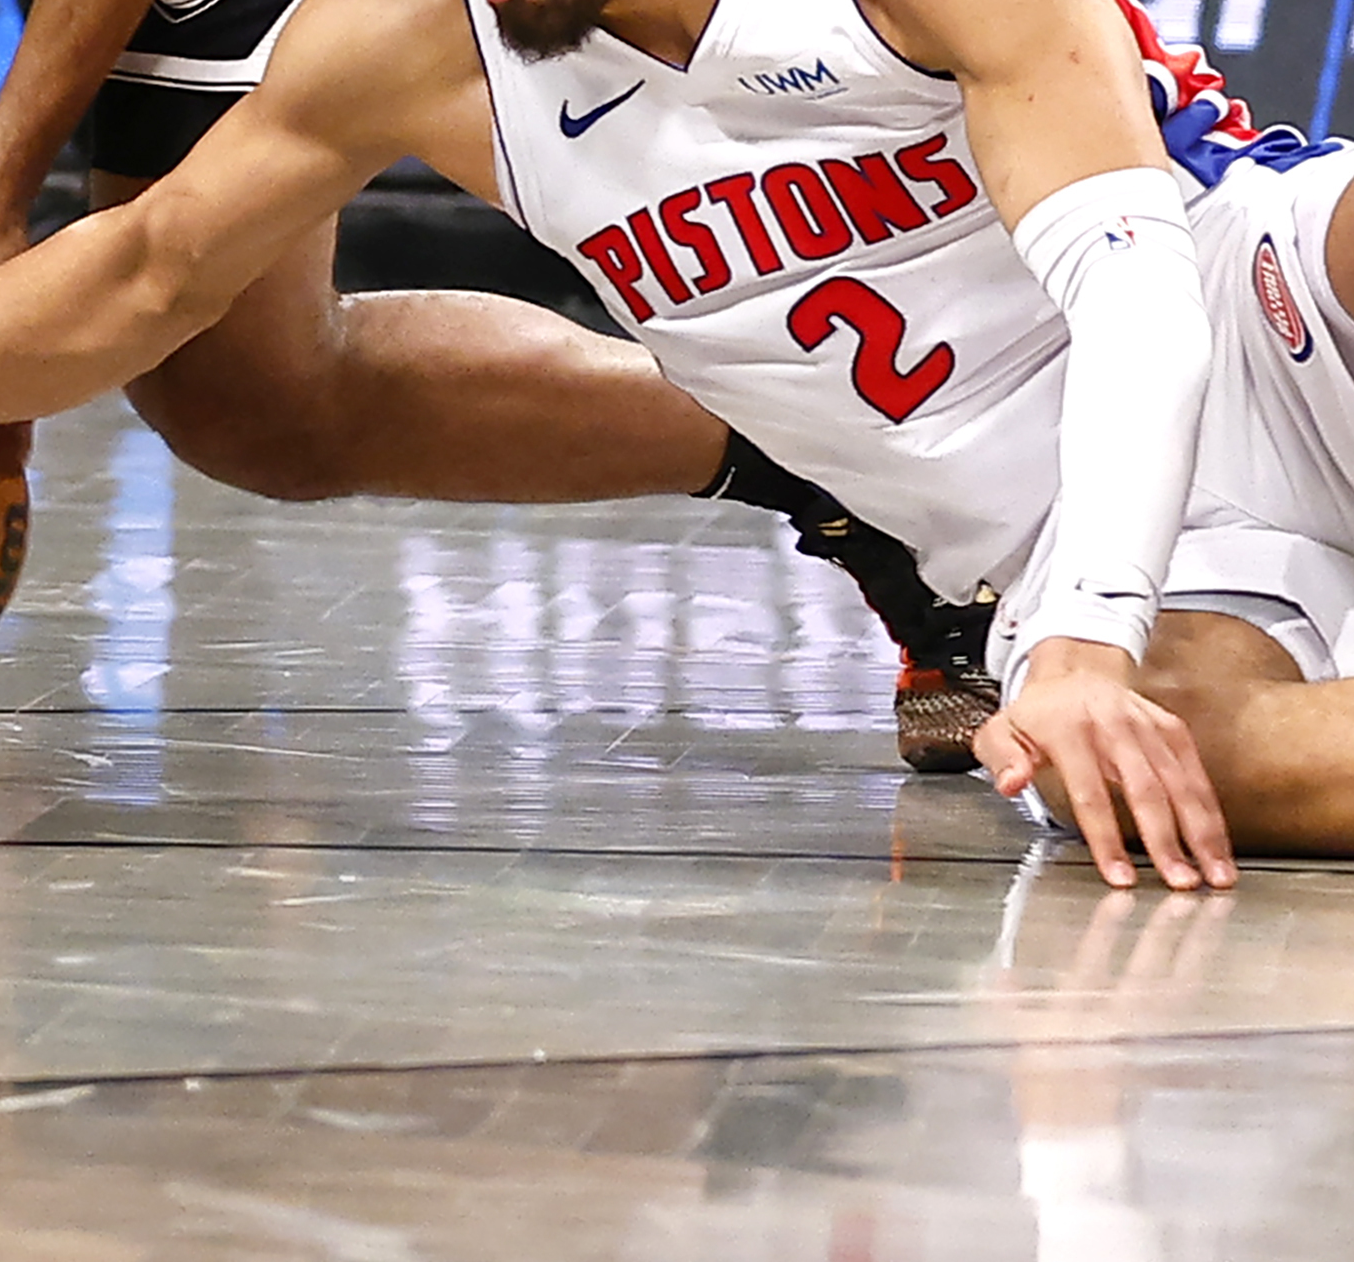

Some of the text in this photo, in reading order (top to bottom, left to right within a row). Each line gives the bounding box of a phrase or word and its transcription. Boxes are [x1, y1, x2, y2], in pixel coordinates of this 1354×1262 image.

[737, 56, 841, 96] UWM
[576, 132, 979, 325] PISTONS
[785, 276, 956, 425] 2
